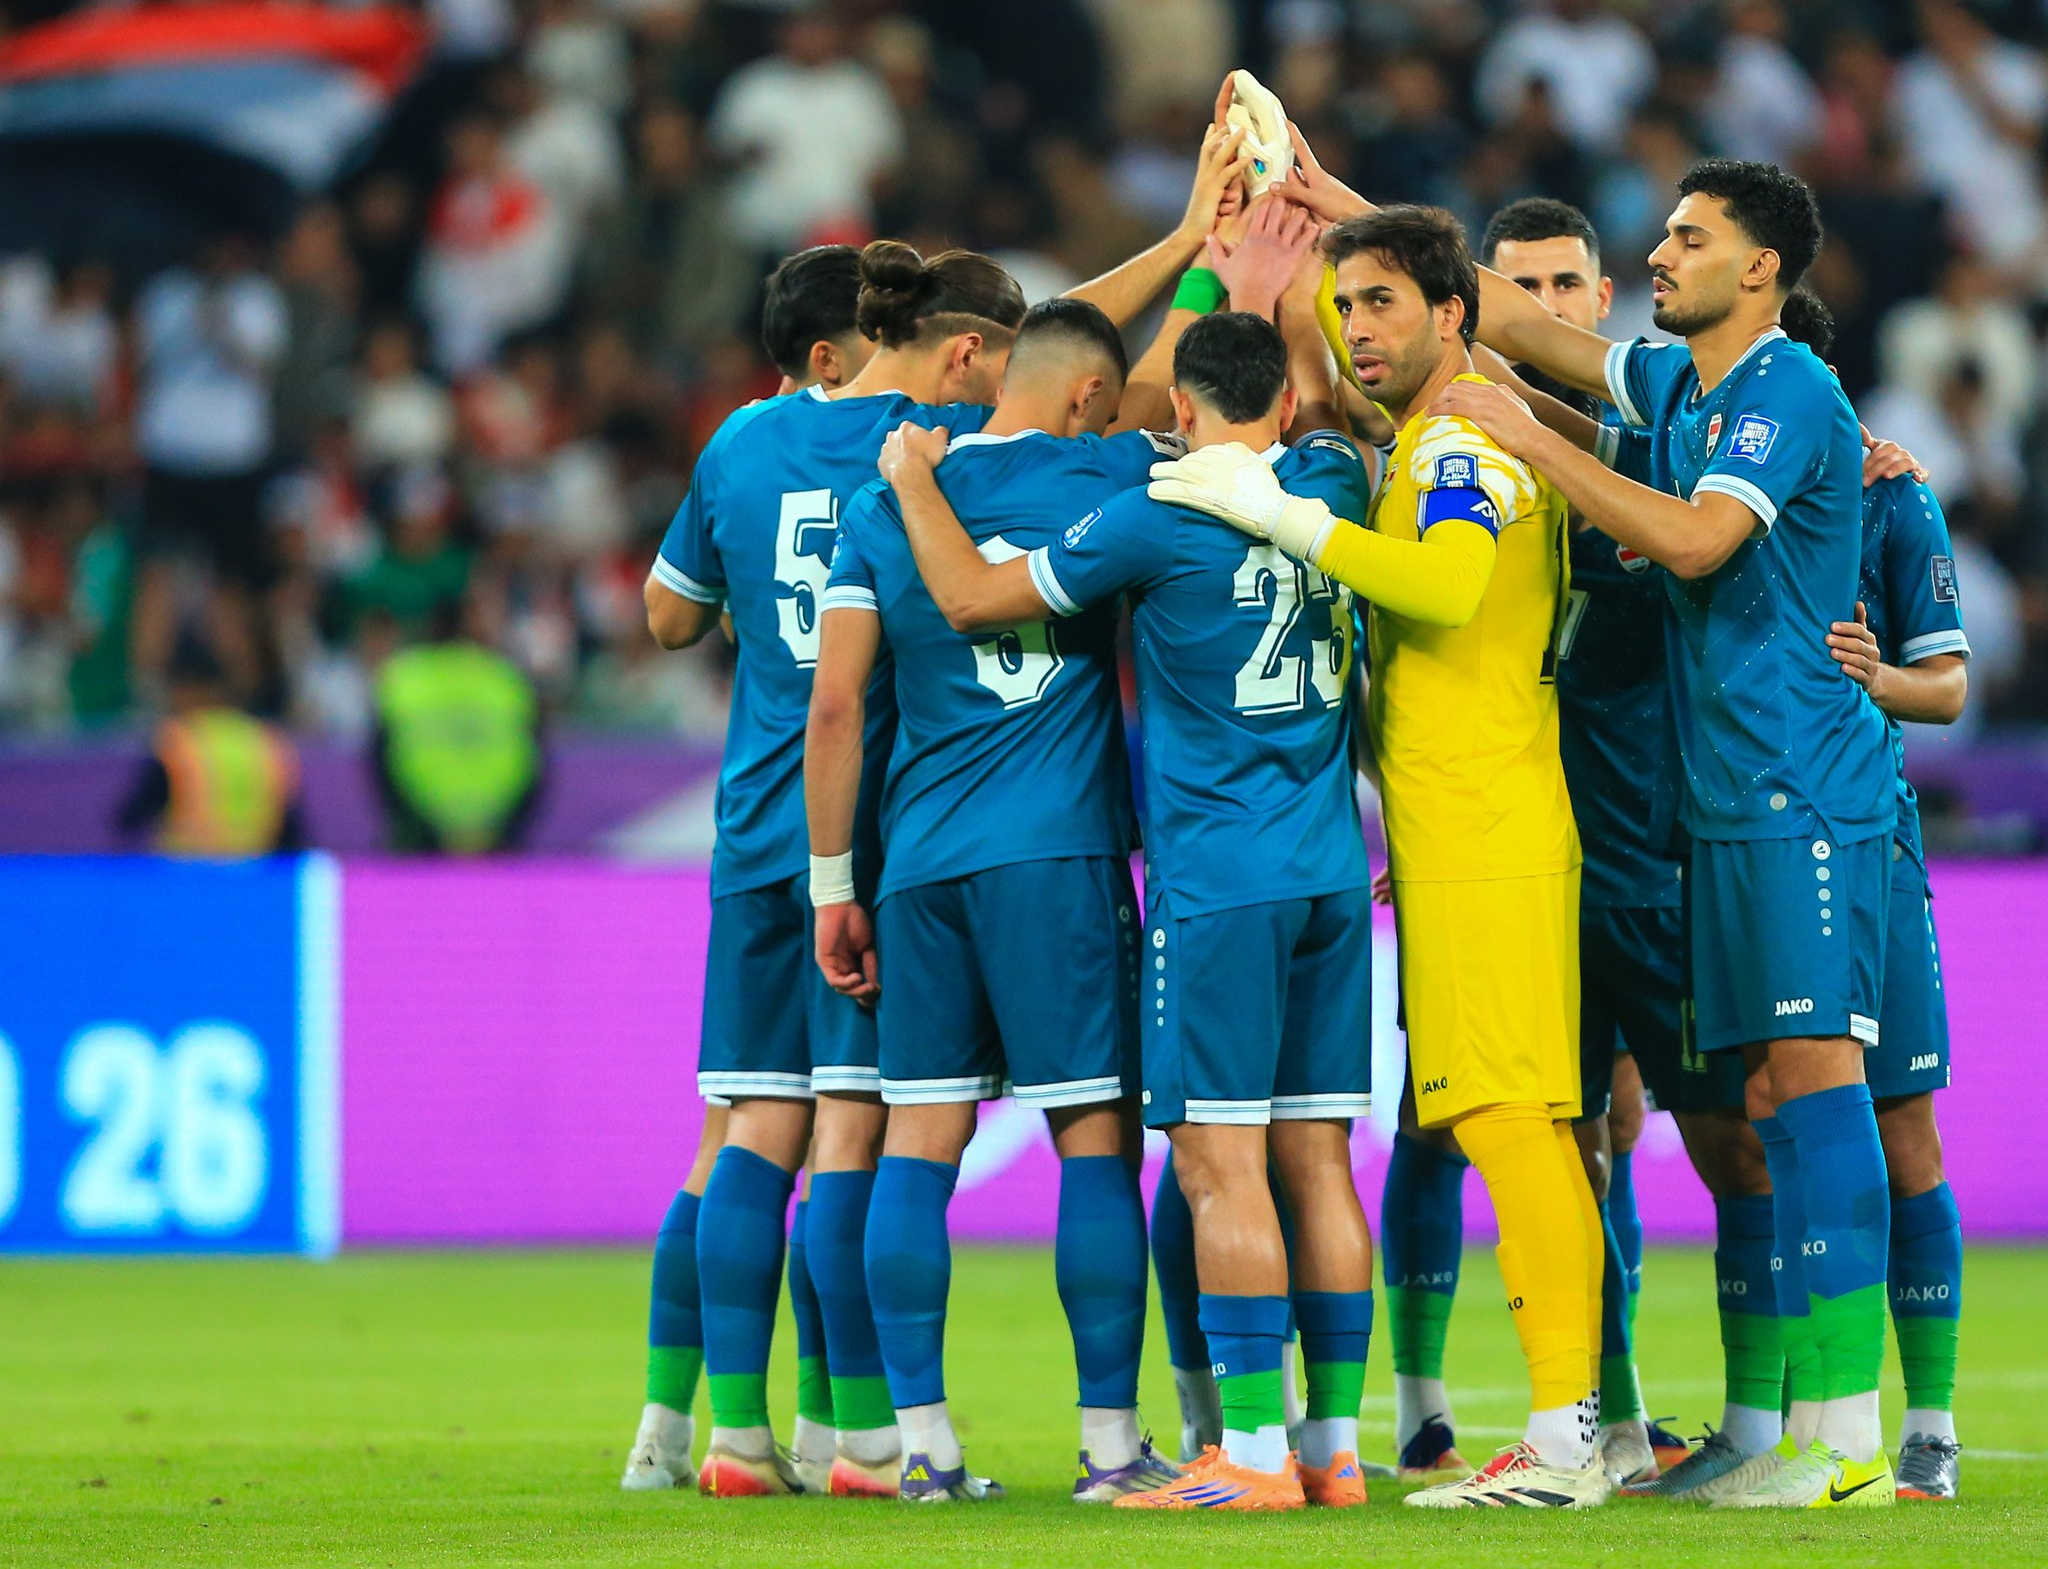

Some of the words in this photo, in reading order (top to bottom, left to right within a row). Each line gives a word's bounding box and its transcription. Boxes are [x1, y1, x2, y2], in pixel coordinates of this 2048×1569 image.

[773, 488, 839, 669] 5
[1232, 545, 1354, 716] 23
[1775, 998, 1814, 1016] JAKO
[1910, 1053, 1939, 1070] JAKO
[1422, 1077, 1447, 1095] JAKO
[62, 1023, 264, 1231] 26
[1801, 1240, 1827, 1256] KO
[1897, 1285, 1949, 1301] JAKO
